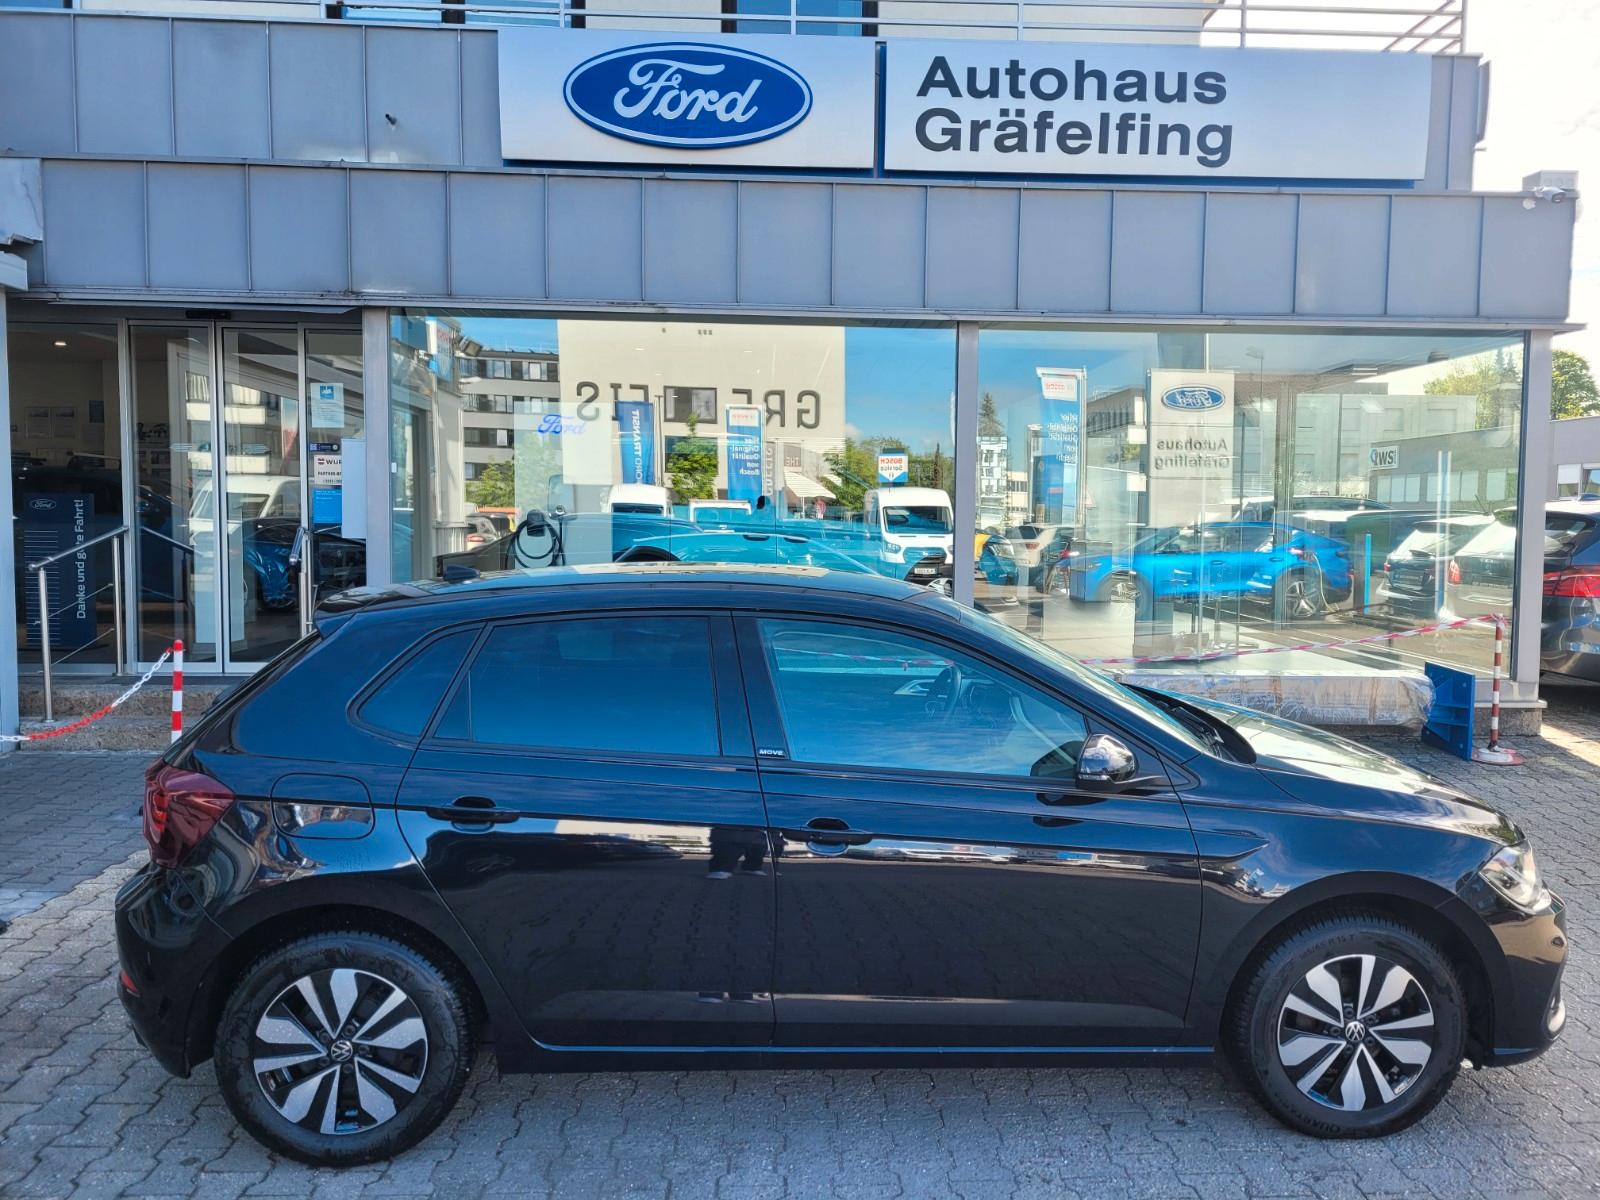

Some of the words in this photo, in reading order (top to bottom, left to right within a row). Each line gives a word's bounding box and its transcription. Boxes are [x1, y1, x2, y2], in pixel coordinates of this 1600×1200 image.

[613, 58, 763, 123] Ford
[916, 56, 1227, 105] Autohaus
[915, 107, 1233, 168] Gräfelfing
[538, 414, 586, 435] Ford
[74, 499, 84, 532] Fahrt!
[75, 535, 87, 560] gte
[75, 561, 85, 582] und
[76, 586, 86, 619] Danke
